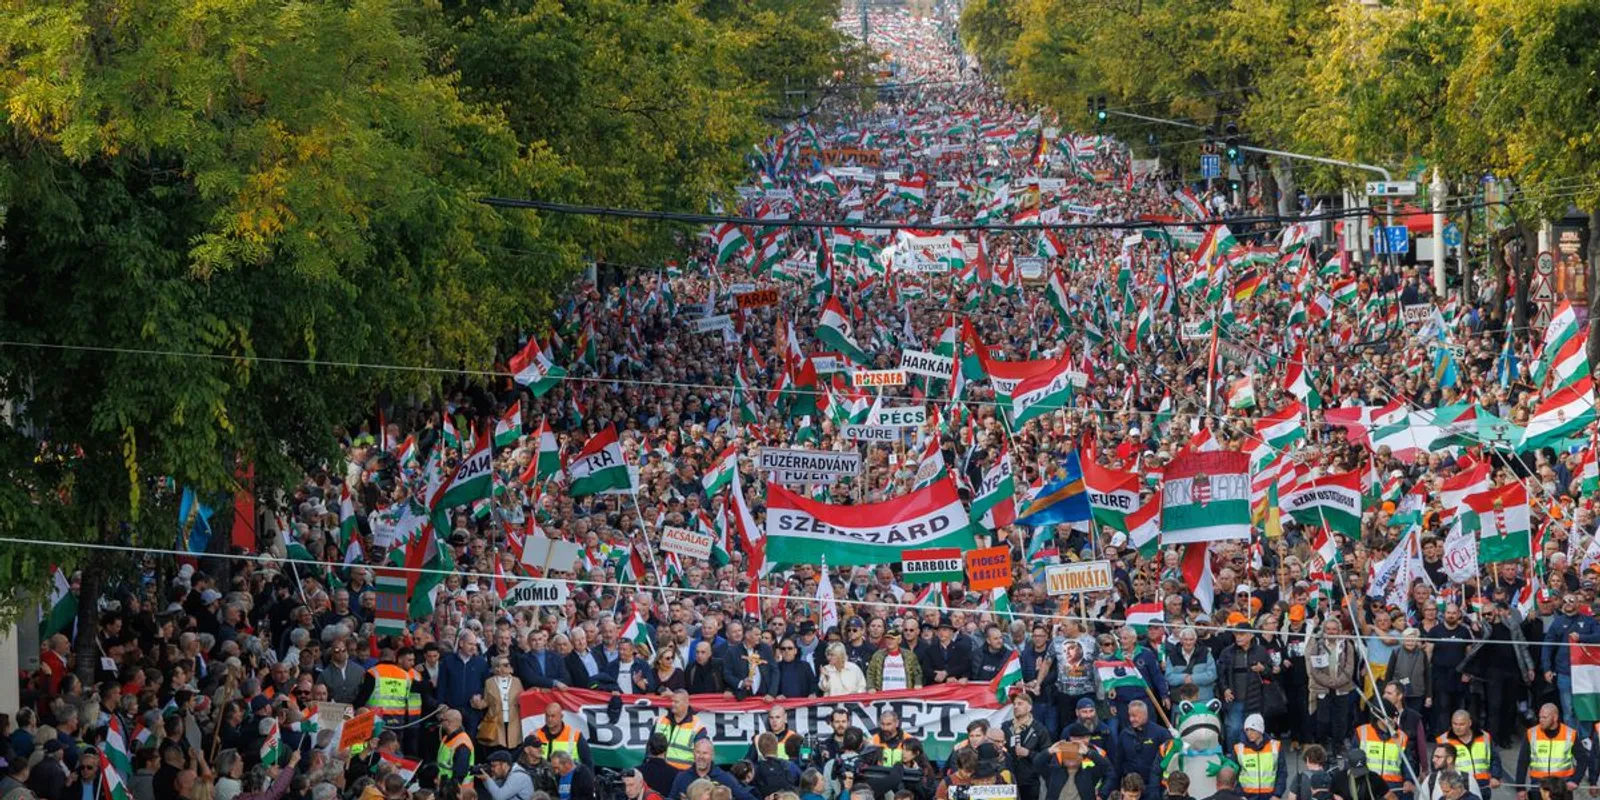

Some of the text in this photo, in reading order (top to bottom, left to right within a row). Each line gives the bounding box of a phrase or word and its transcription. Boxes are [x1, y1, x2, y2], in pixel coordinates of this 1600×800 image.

[1429, 345, 1464, 357] PCS
[902, 355, 953, 374] HARKÁN
[880, 410, 925, 425] PÉCS
[763, 452, 857, 472] FÜZÉRRADVÁNY
[907, 560, 958, 572] GARBOLC
[1050, 566, 1108, 591] NYÍRKÁTA
[515, 584, 558, 601] KOMLÓ
[581, 700, 966, 746] BÉEMENET
